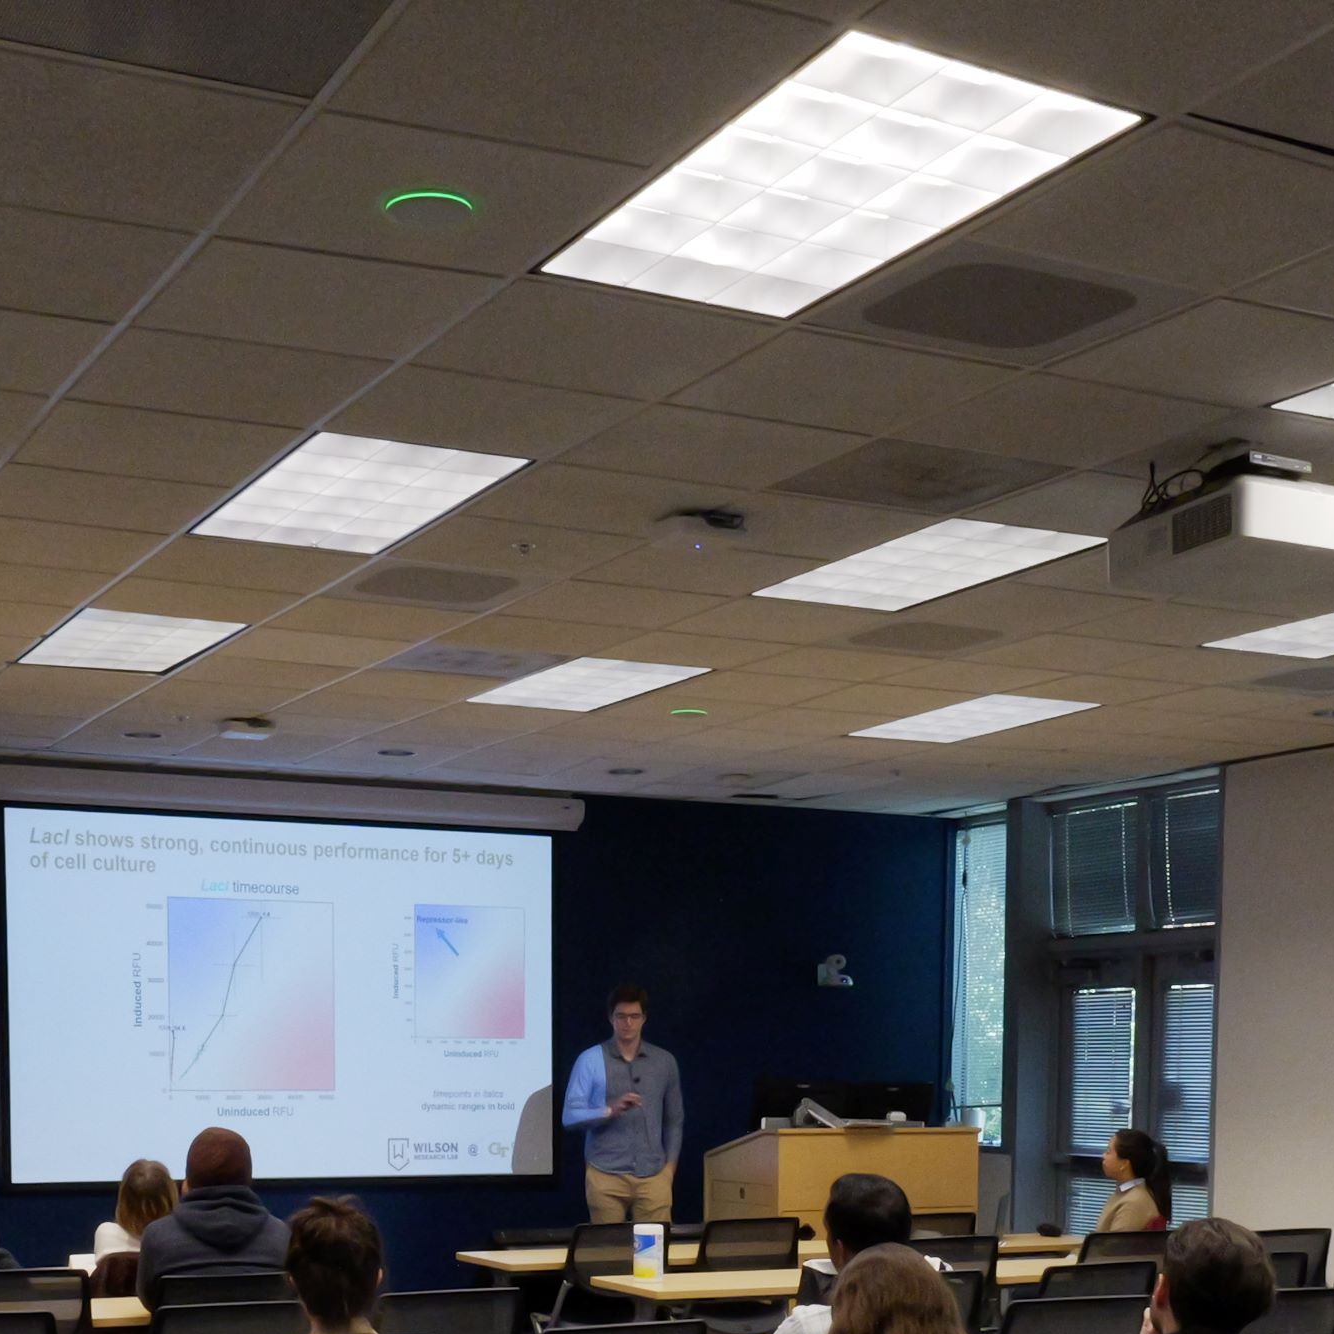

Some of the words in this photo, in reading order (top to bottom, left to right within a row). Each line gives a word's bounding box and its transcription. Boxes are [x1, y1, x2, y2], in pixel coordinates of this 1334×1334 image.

[29, 827, 70, 846] LacI
[74, 830, 135, 849] shows
[140, 833, 204, 857] strong,
[210, 836, 307, 857] continuous
[313, 842, 419, 862] performance
[424, 846, 448, 863] for
[451, 848, 471, 864] 5+
[475, 849, 514, 870] days
[29, 851, 49, 869] of
[54, 853, 87, 870] cell
[92, 855, 157, 873] culture
[232, 880, 300, 896] timecourse
[132, 952, 142, 977] RFU
[133, 981, 143, 1028] Induced
[216, 1106, 270, 1117] Uninduced
[272, 1106, 295, 1117] RFU
[421, 1102, 456, 1112] dynamic
[458, 1104, 486, 1112] ranges
[487, 1102, 496, 1111] in
[497, 1102, 515, 1111] bold
[413, 1142, 459, 1153] WILSON
